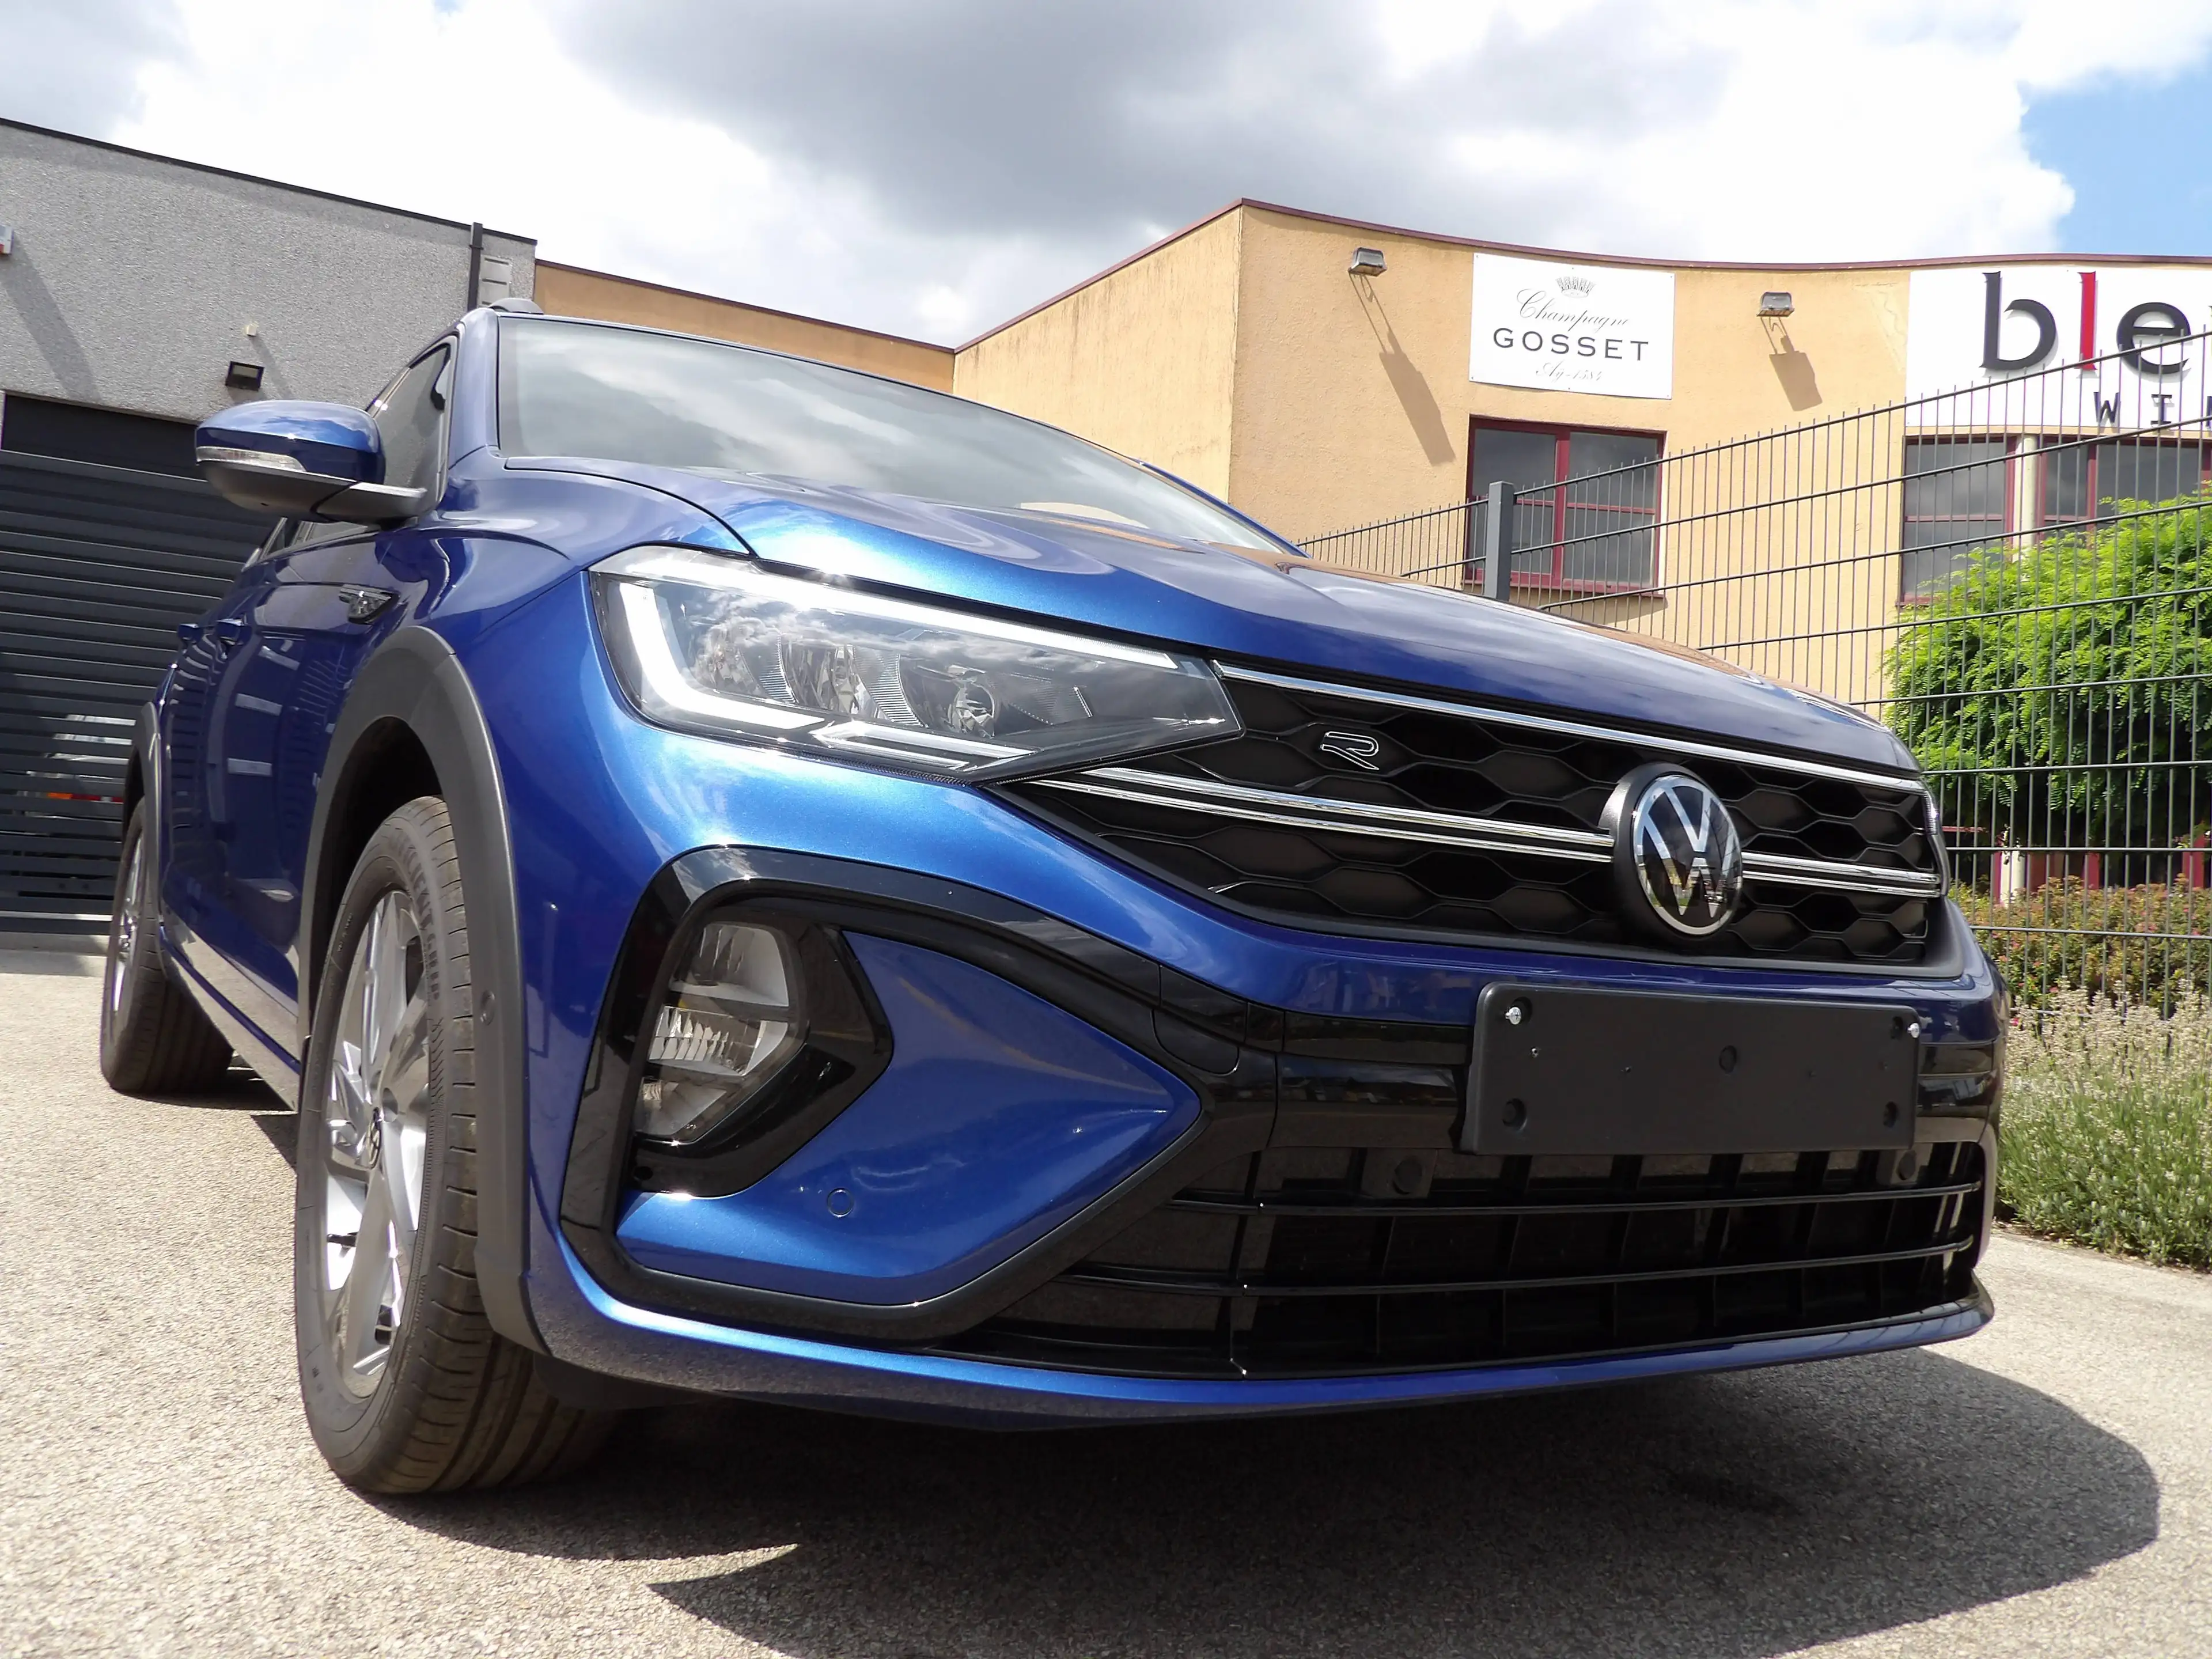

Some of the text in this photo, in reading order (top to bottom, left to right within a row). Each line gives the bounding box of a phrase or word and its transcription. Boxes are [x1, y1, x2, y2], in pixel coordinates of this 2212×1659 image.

[1516, 288, 1630, 334] Champagne
[1980, 270, 2212, 376] ble
[1493, 327, 1649, 362] GOSSET
[2093, 391, 2212, 428] WI
[1320, 730, 1380, 771] R
[1639, 778, 1739, 923] VW
